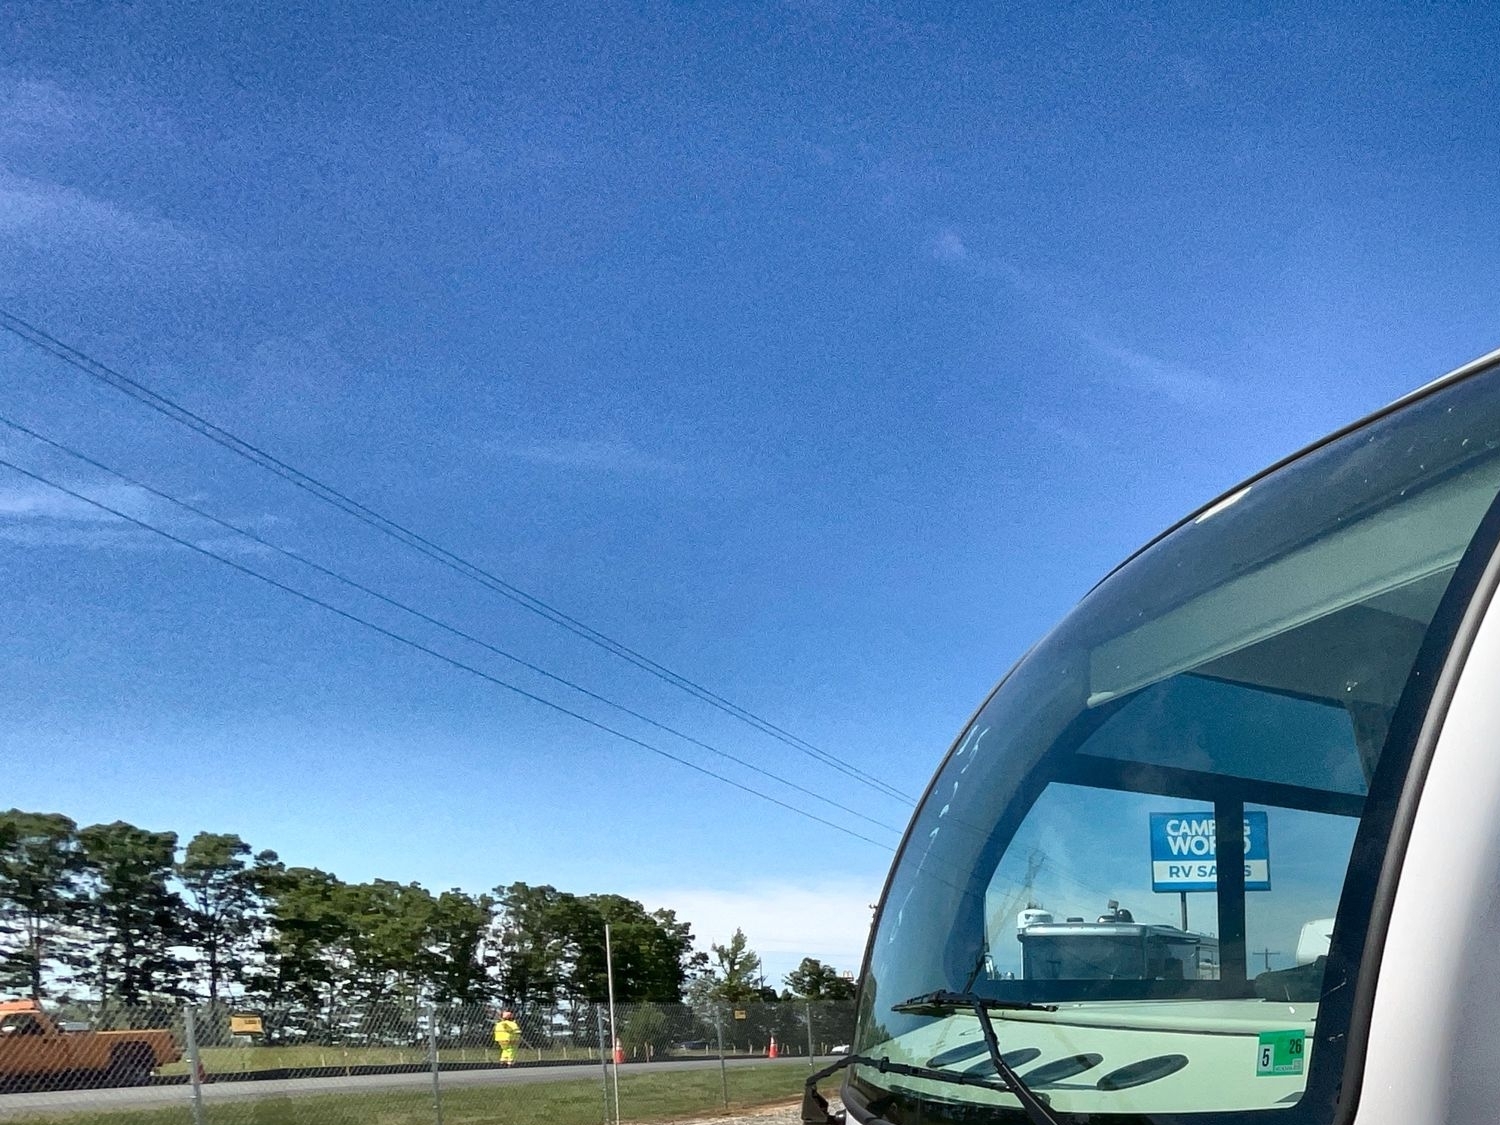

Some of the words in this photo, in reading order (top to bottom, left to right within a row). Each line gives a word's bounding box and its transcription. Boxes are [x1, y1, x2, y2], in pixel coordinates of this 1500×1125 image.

[1166, 819, 1251, 836] CAMPG
[1169, 865, 1192, 878] RV
[1197, 865, 1252, 877] SAS
[1288, 1038, 1302, 1055] 26
[1262, 1048, 1270, 1067] 5
